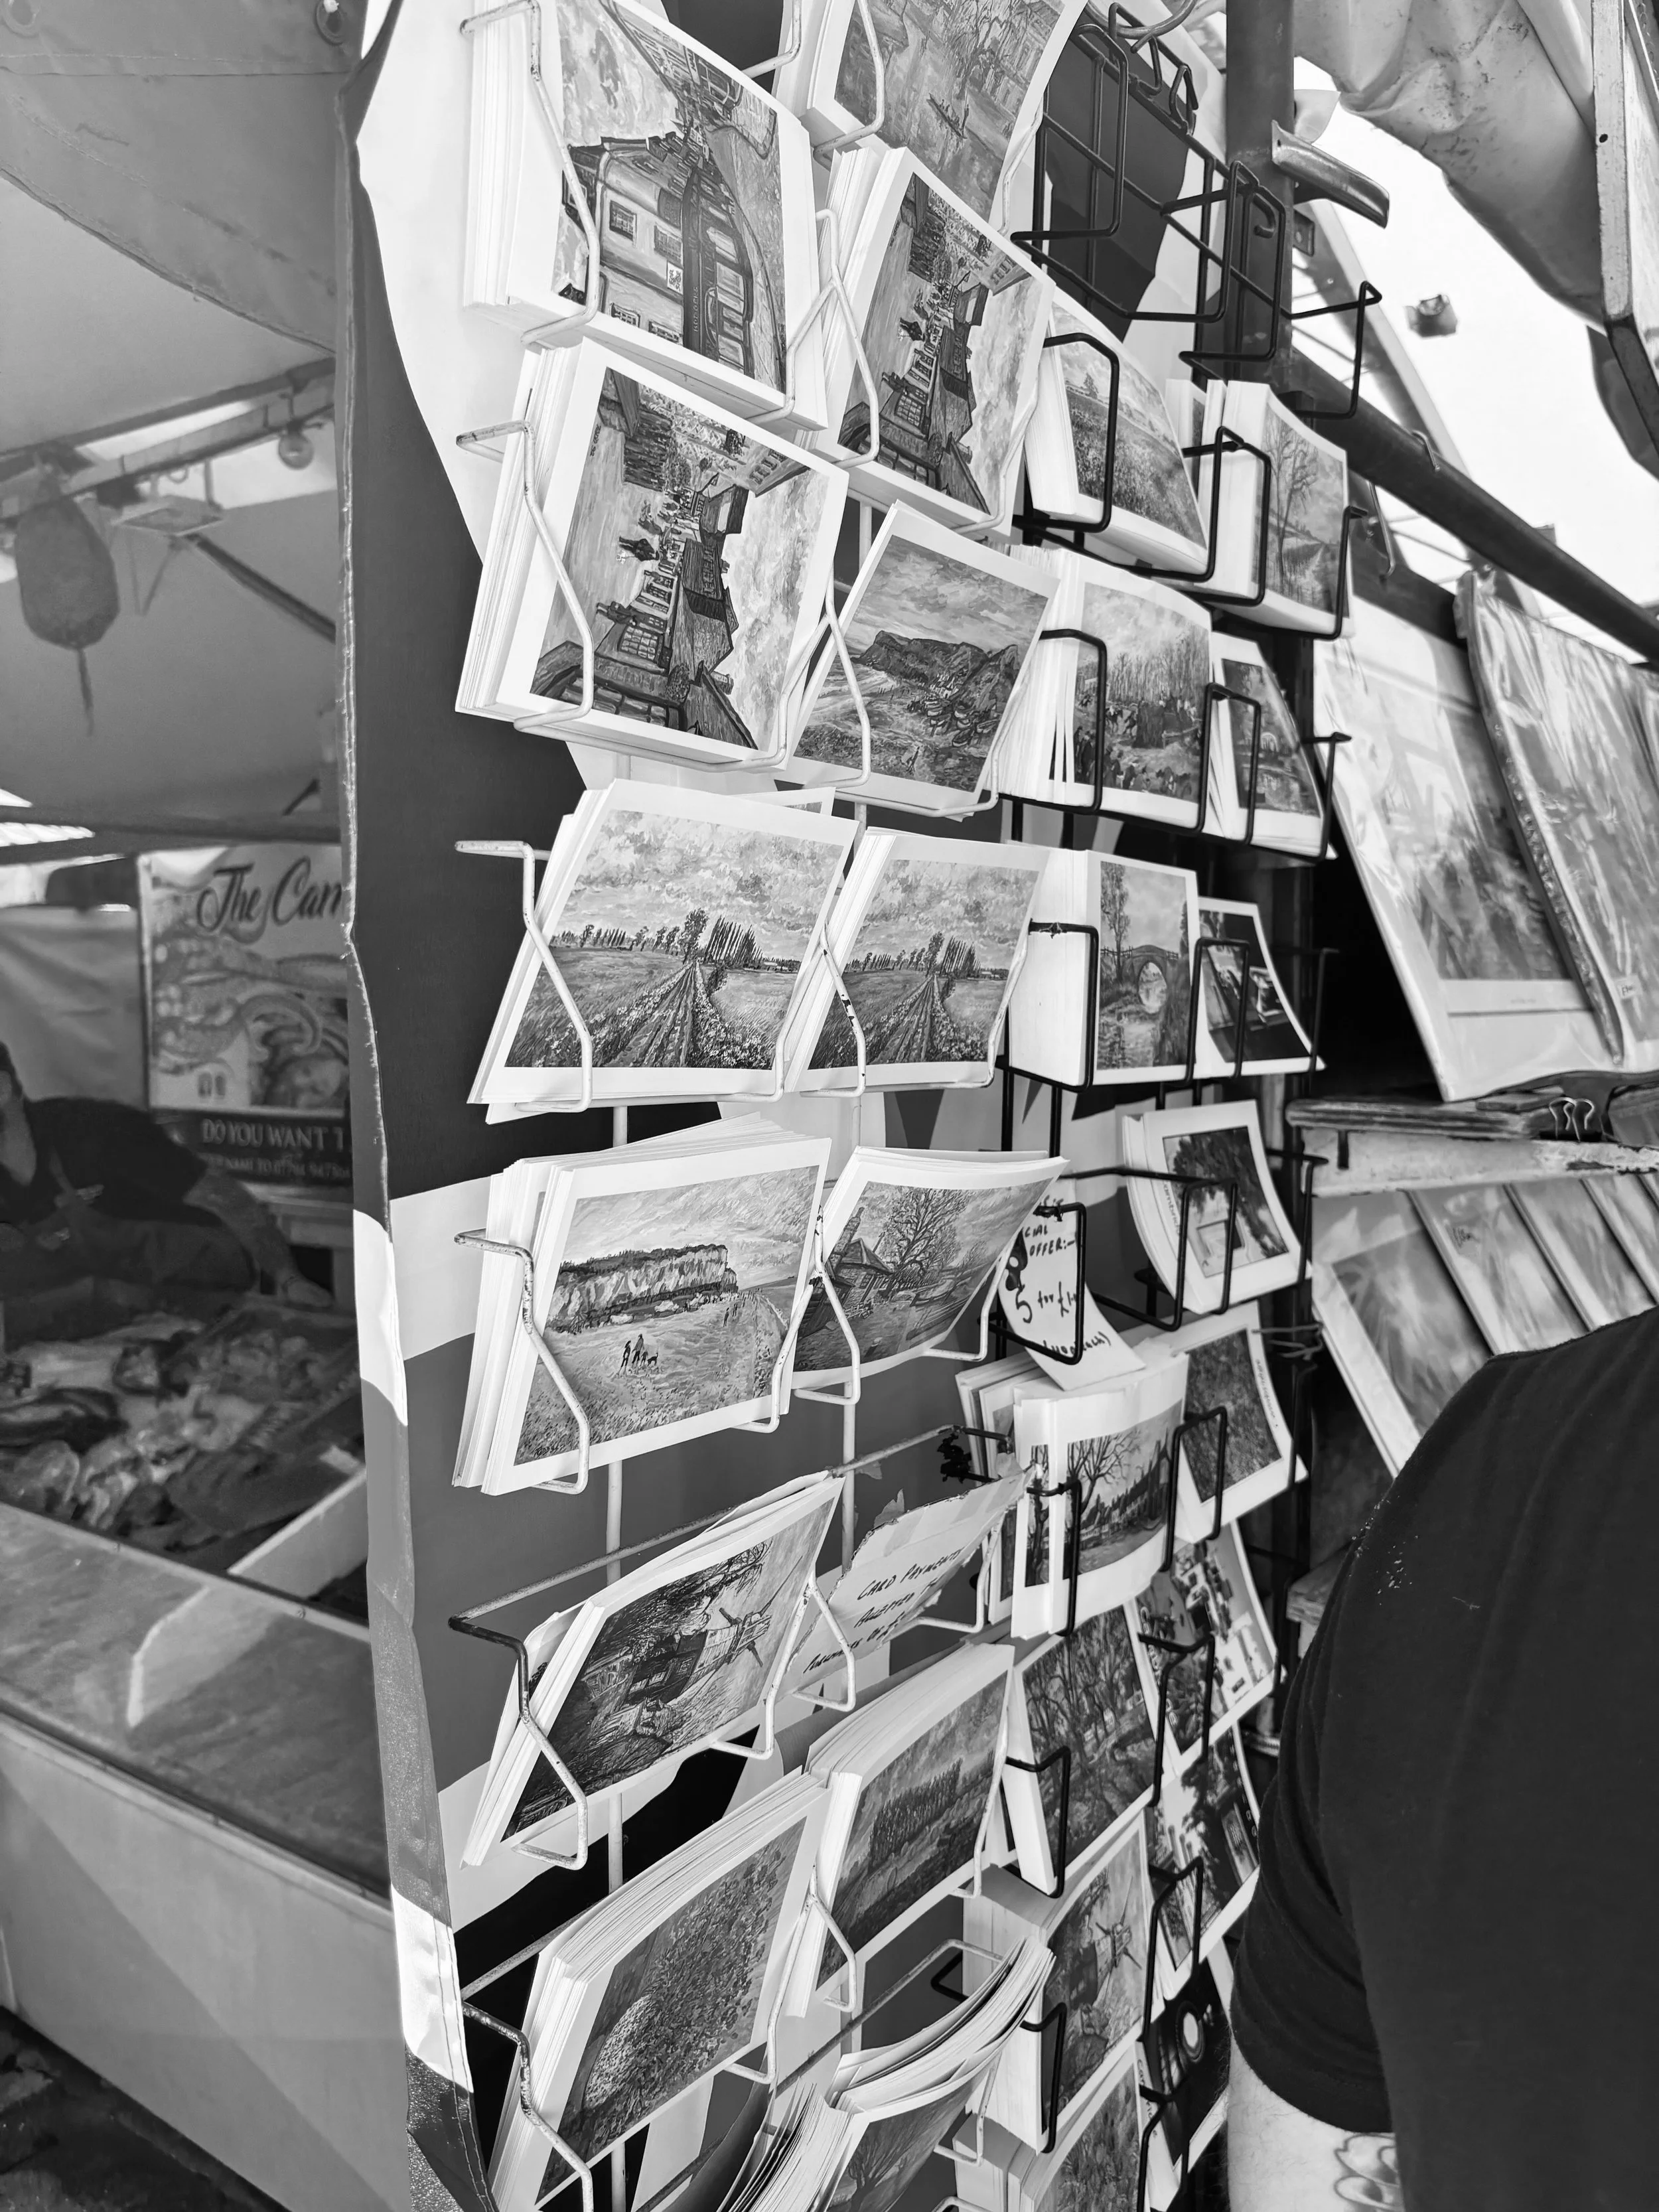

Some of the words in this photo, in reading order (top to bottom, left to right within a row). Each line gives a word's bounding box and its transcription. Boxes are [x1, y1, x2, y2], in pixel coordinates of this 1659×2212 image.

[197, 863, 265, 932] The
[202, 1118, 226, 1144] DO
[227, 1120, 263, 1147] YOU
[266, 1123, 329, 1151] WANT
[1015, 1284, 1033, 1324] 5
[1037, 1290, 1054, 1309] for
[857, 1574, 897, 1600] CARD
[900, 1548, 962, 1584] PAYMENTS
